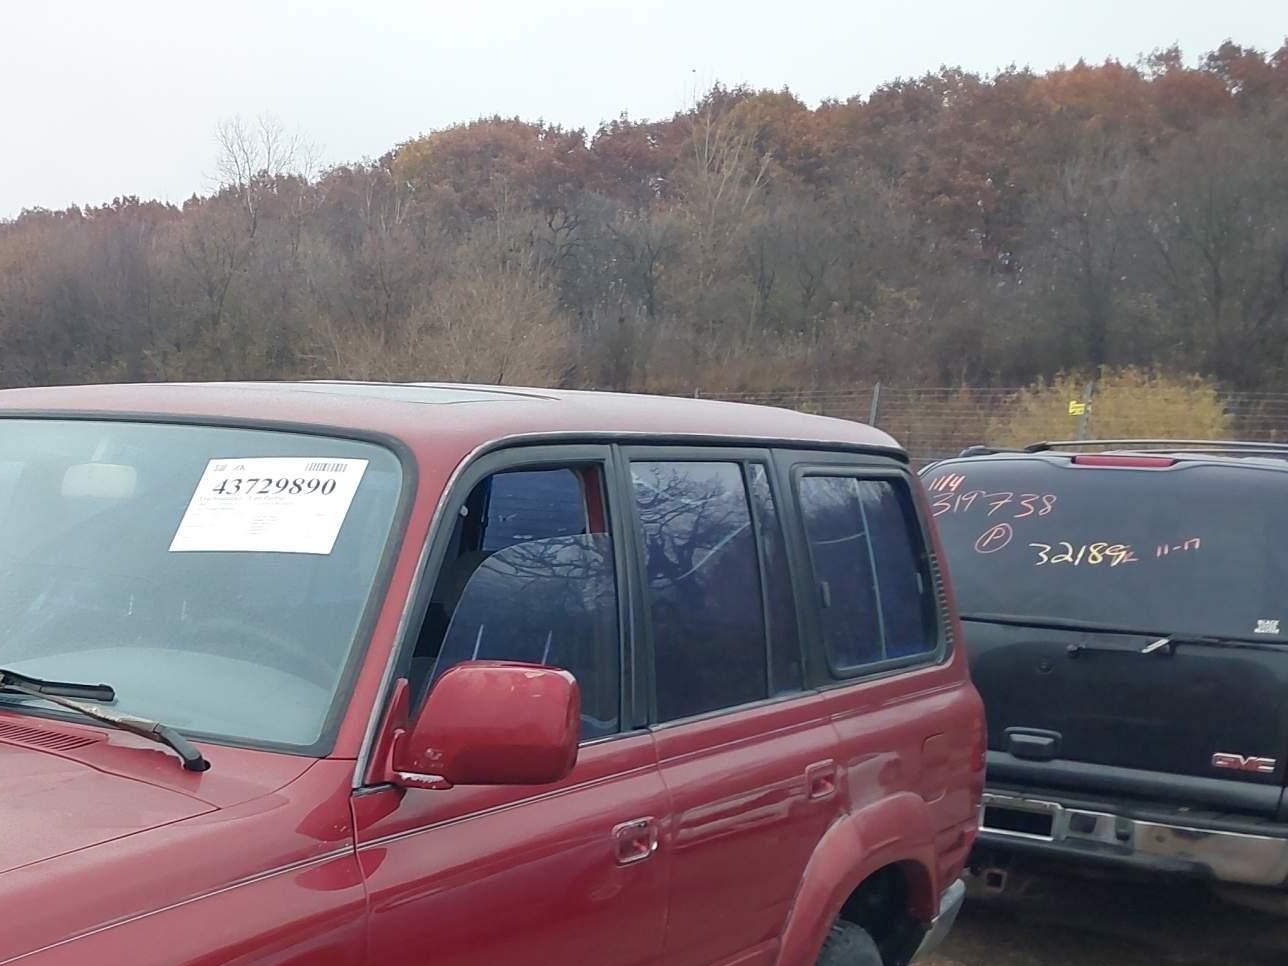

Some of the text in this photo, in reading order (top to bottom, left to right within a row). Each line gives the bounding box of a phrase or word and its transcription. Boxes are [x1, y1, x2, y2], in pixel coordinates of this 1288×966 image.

[212, 477, 337, 496] 43729890
[932, 489, 1057, 518] 319738
[980, 525, 1009, 549] P
[1213, 752, 1277, 774] GMC
